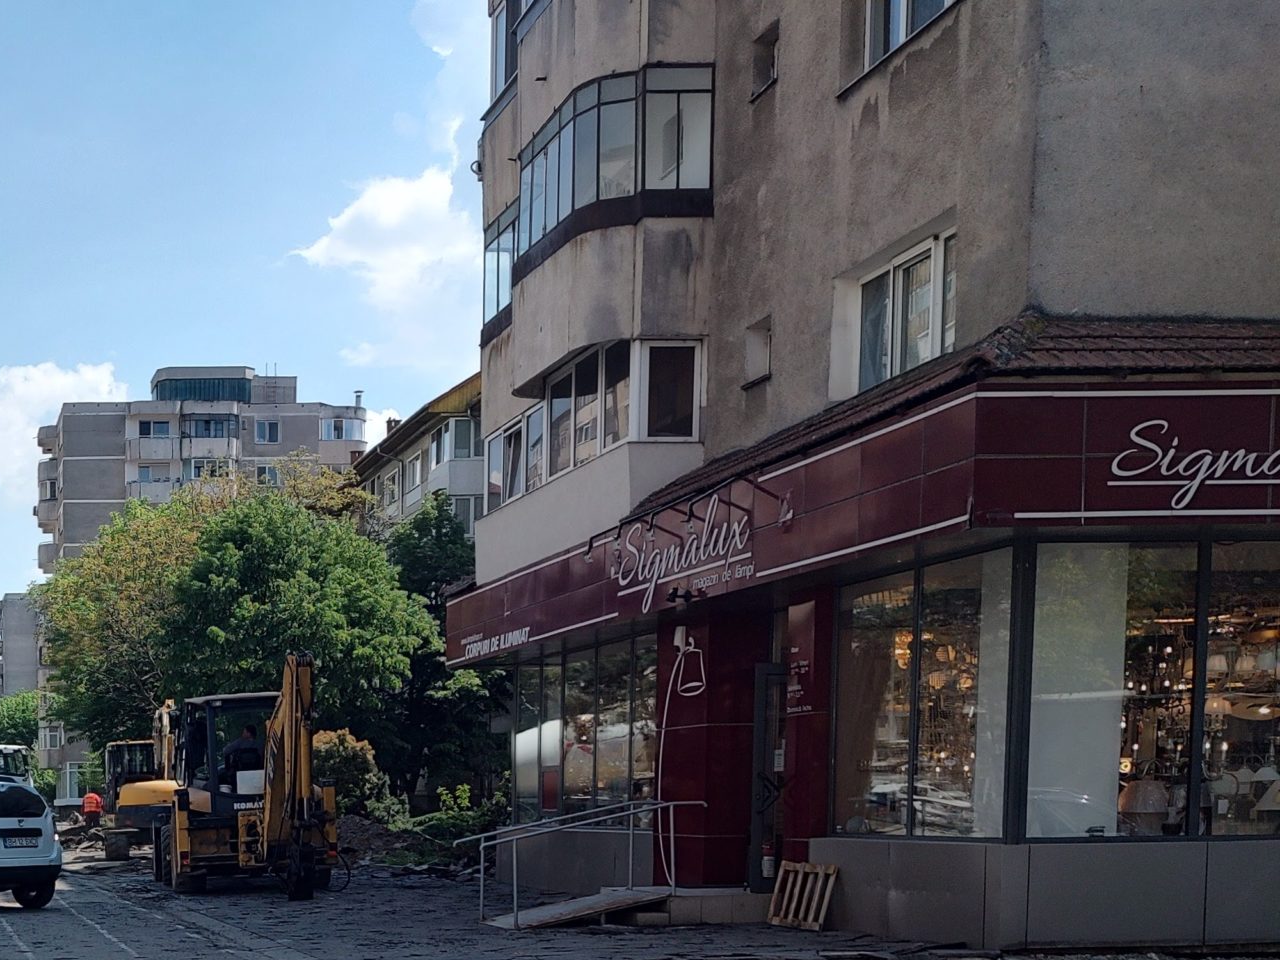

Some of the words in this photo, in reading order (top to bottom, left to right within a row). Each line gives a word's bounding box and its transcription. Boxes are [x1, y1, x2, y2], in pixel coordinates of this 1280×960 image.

[618, 494, 750, 613] Sigmalux
[692, 572, 719, 591] magazin
[722, 566, 732, 582] de
[465, 638, 490, 659] CORPURI
[490, 635, 500, 652] DE
[500, 626, 531, 649] ILUMINAT
